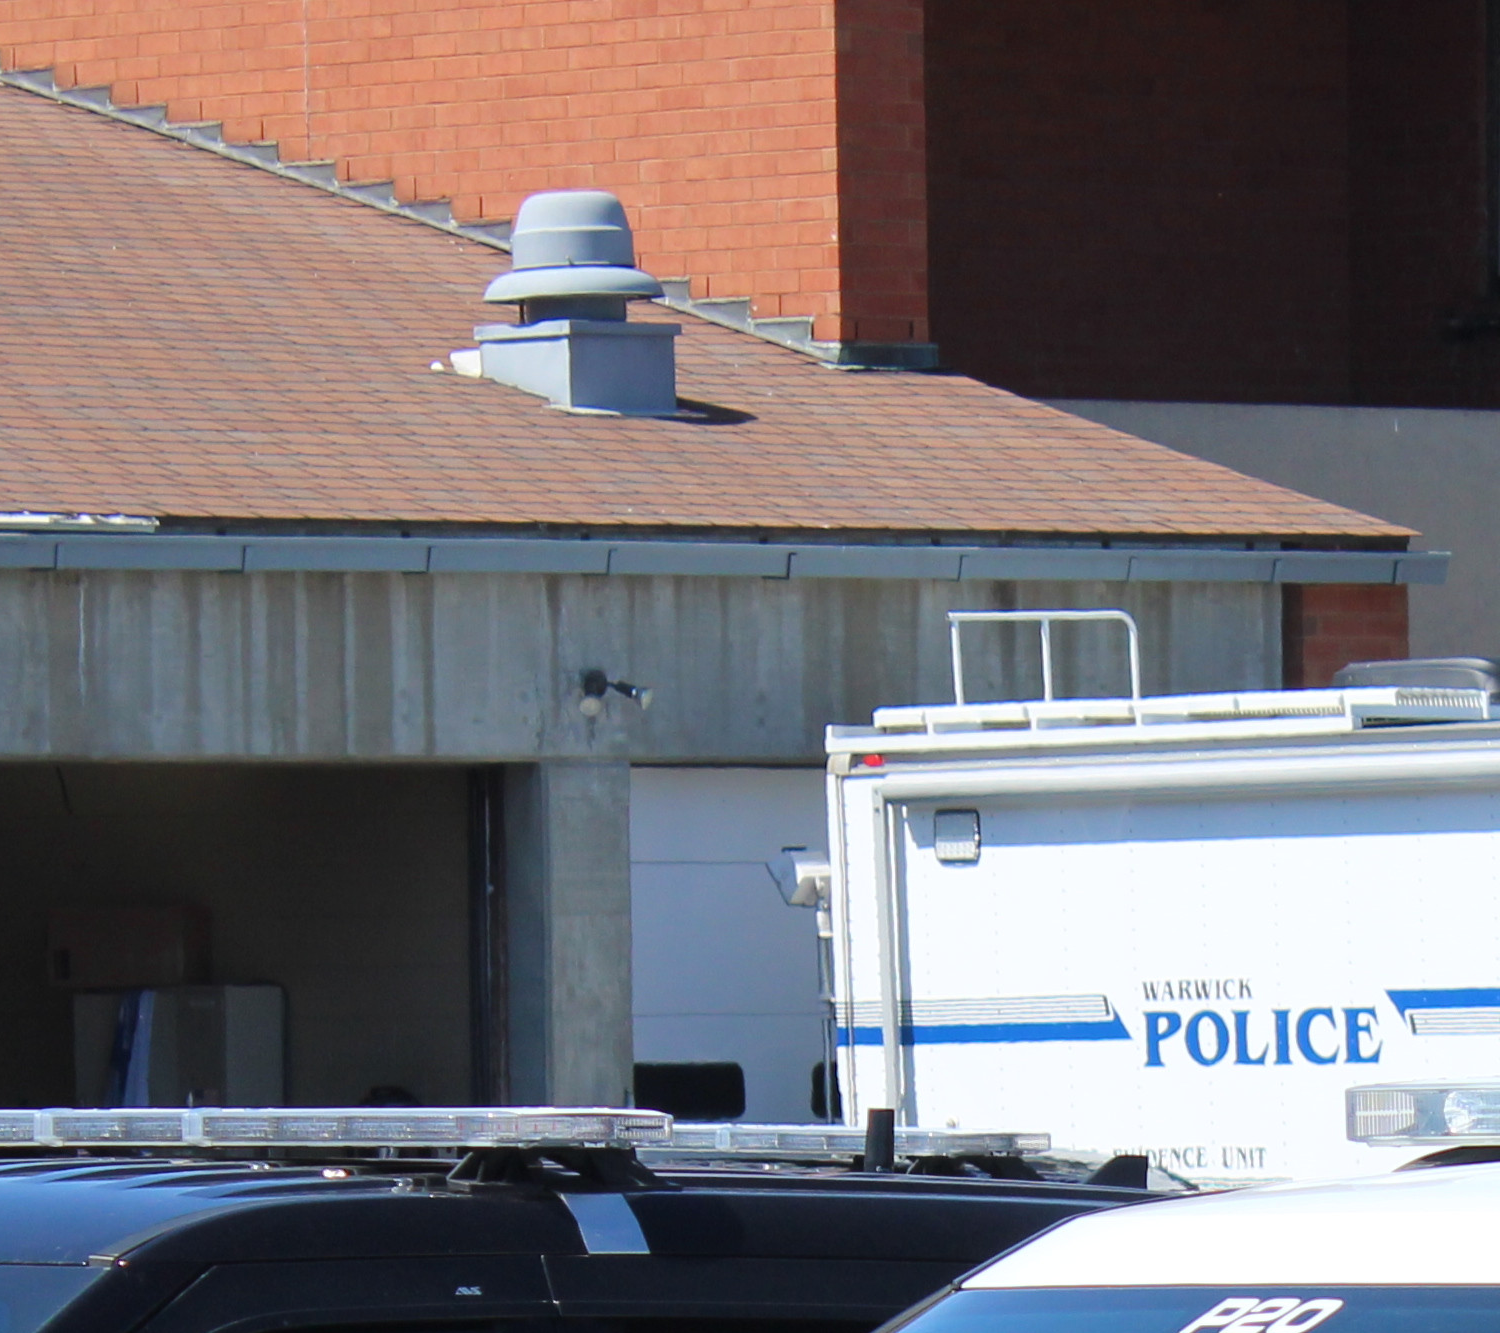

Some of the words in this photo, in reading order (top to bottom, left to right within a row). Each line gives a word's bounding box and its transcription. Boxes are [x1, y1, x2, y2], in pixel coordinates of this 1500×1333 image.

[1142, 978, 1253, 1001] WARWICK
[1142, 1006, 1383, 1068] POLICE
[1221, 1146, 1268, 1169] UNIT
